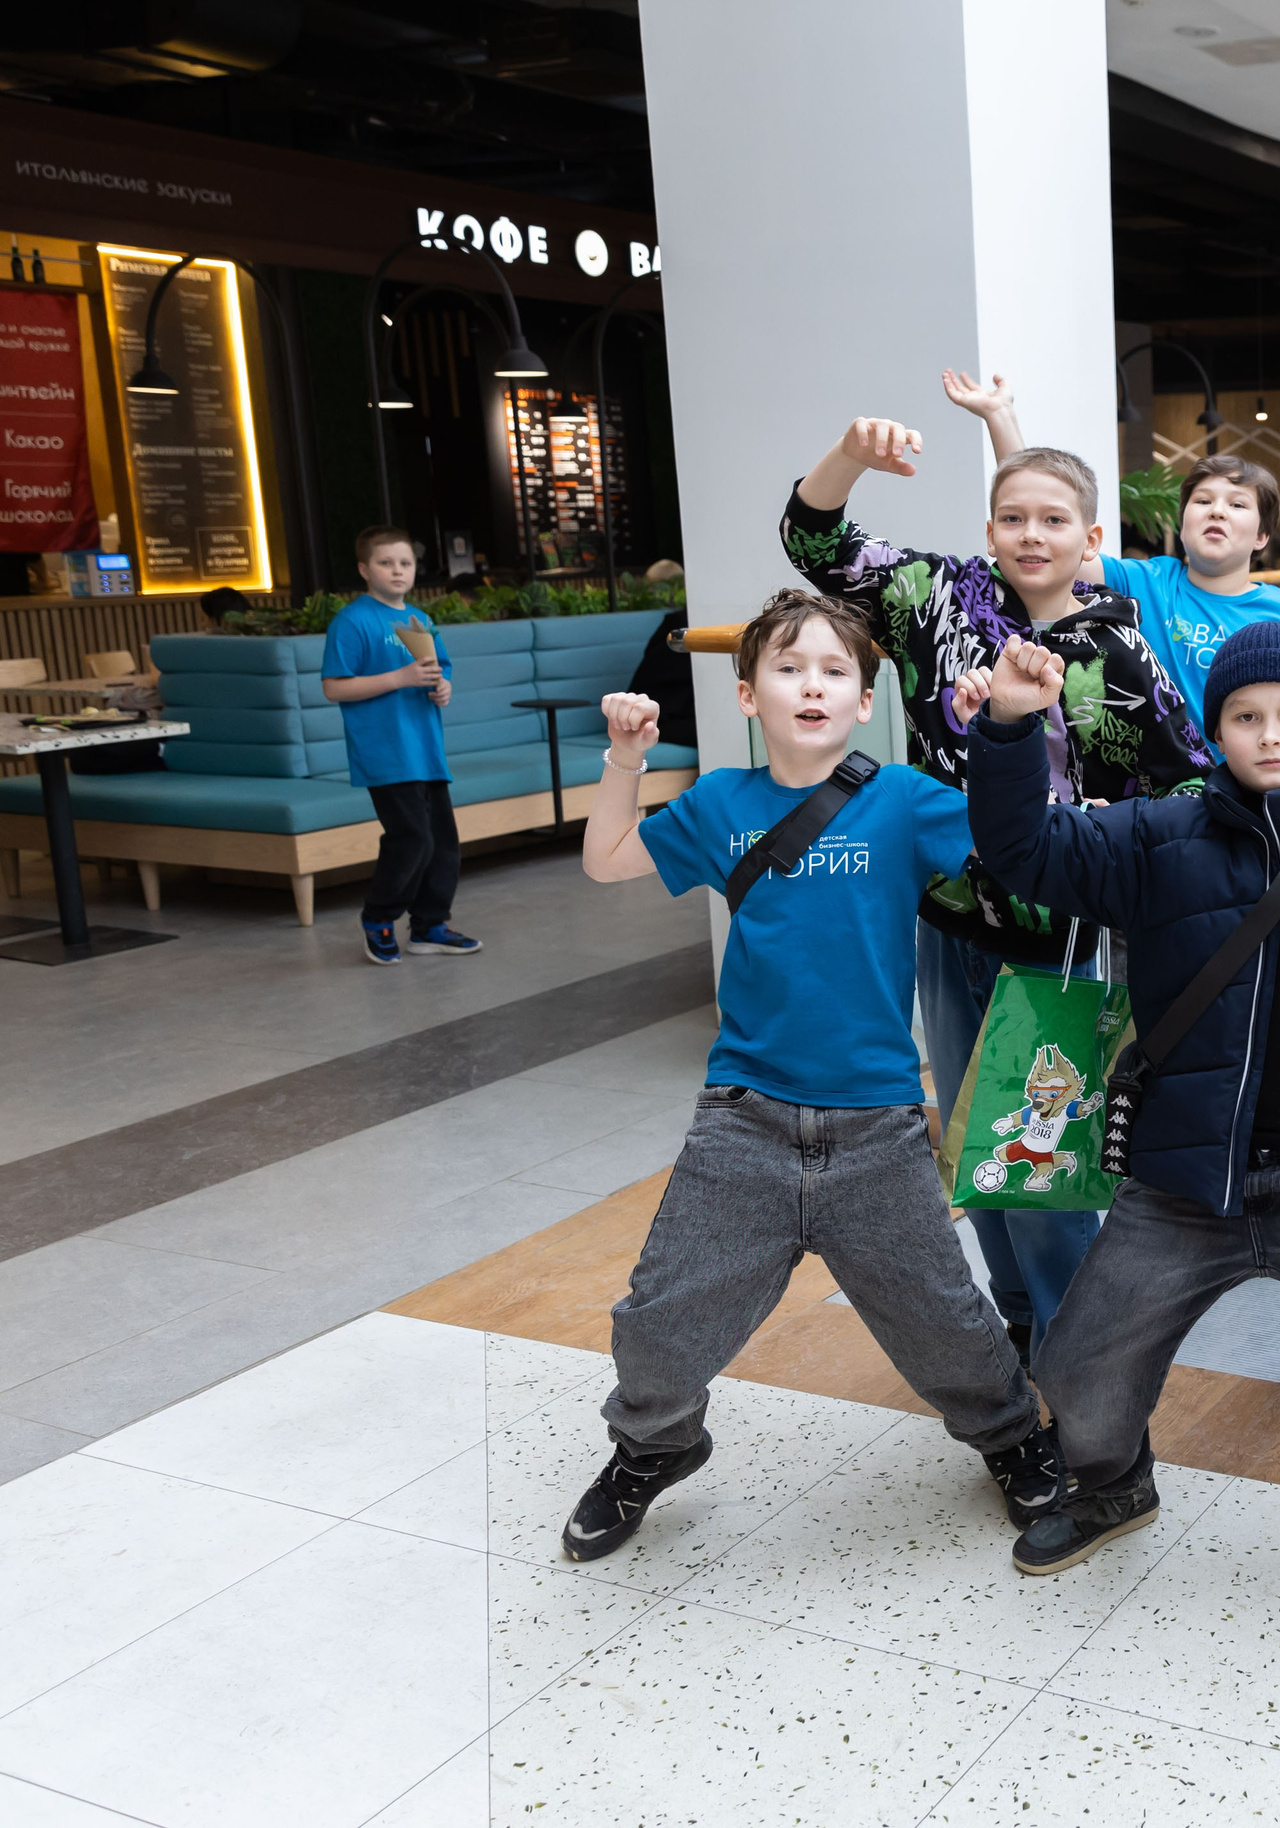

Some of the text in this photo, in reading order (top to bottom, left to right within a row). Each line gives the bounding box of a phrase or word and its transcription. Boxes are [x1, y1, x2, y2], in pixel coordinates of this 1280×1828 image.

[16, 160, 232, 205] итальянские закуски
[417, 207, 549, 264] КОФЕ
[5, 428, 64, 449] Какао
[5, 479, 71, 501] Горячий
[0, 509, 75, 523] шоколад
[1030, 1125, 1052, 1140] 2018
